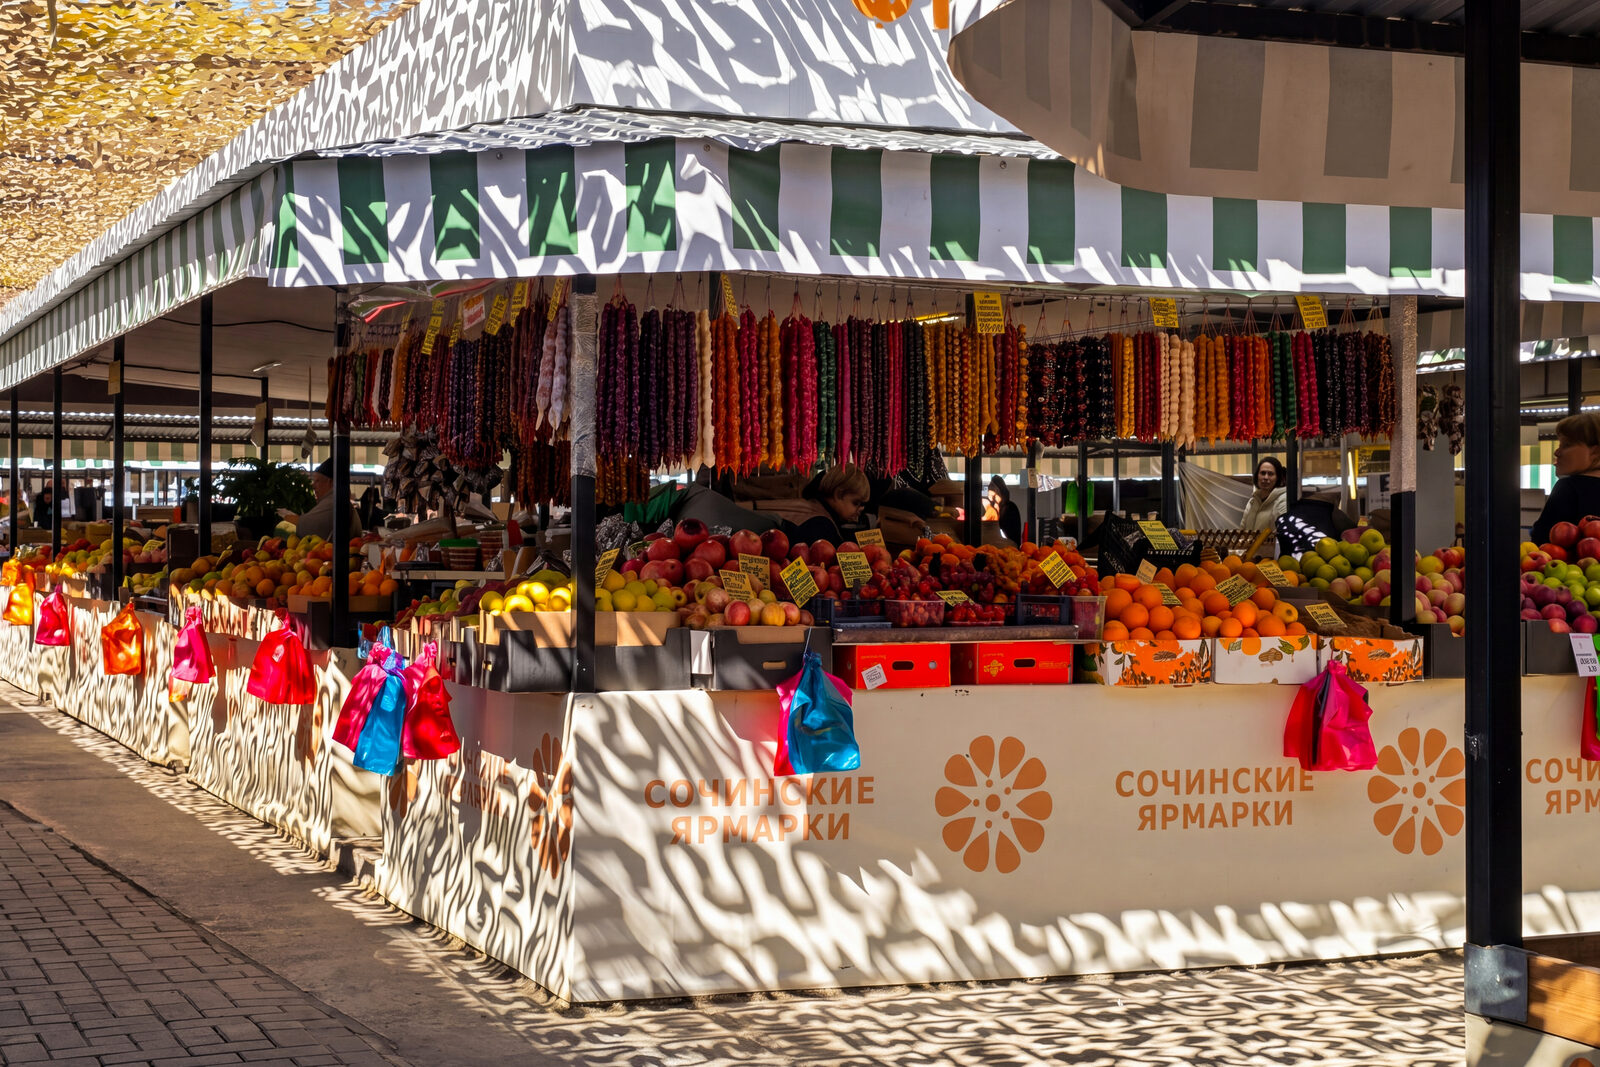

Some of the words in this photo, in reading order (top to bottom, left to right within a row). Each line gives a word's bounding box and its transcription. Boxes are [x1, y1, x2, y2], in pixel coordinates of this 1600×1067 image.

[644, 776, 875, 808] СОЧИНСКИЕ
[1115, 767, 1314, 798] СОЧИНСКИЕ
[670, 813, 850, 845] ЯРМАРКИ
[1137, 800, 1293, 831] ЯРМАРКИ
